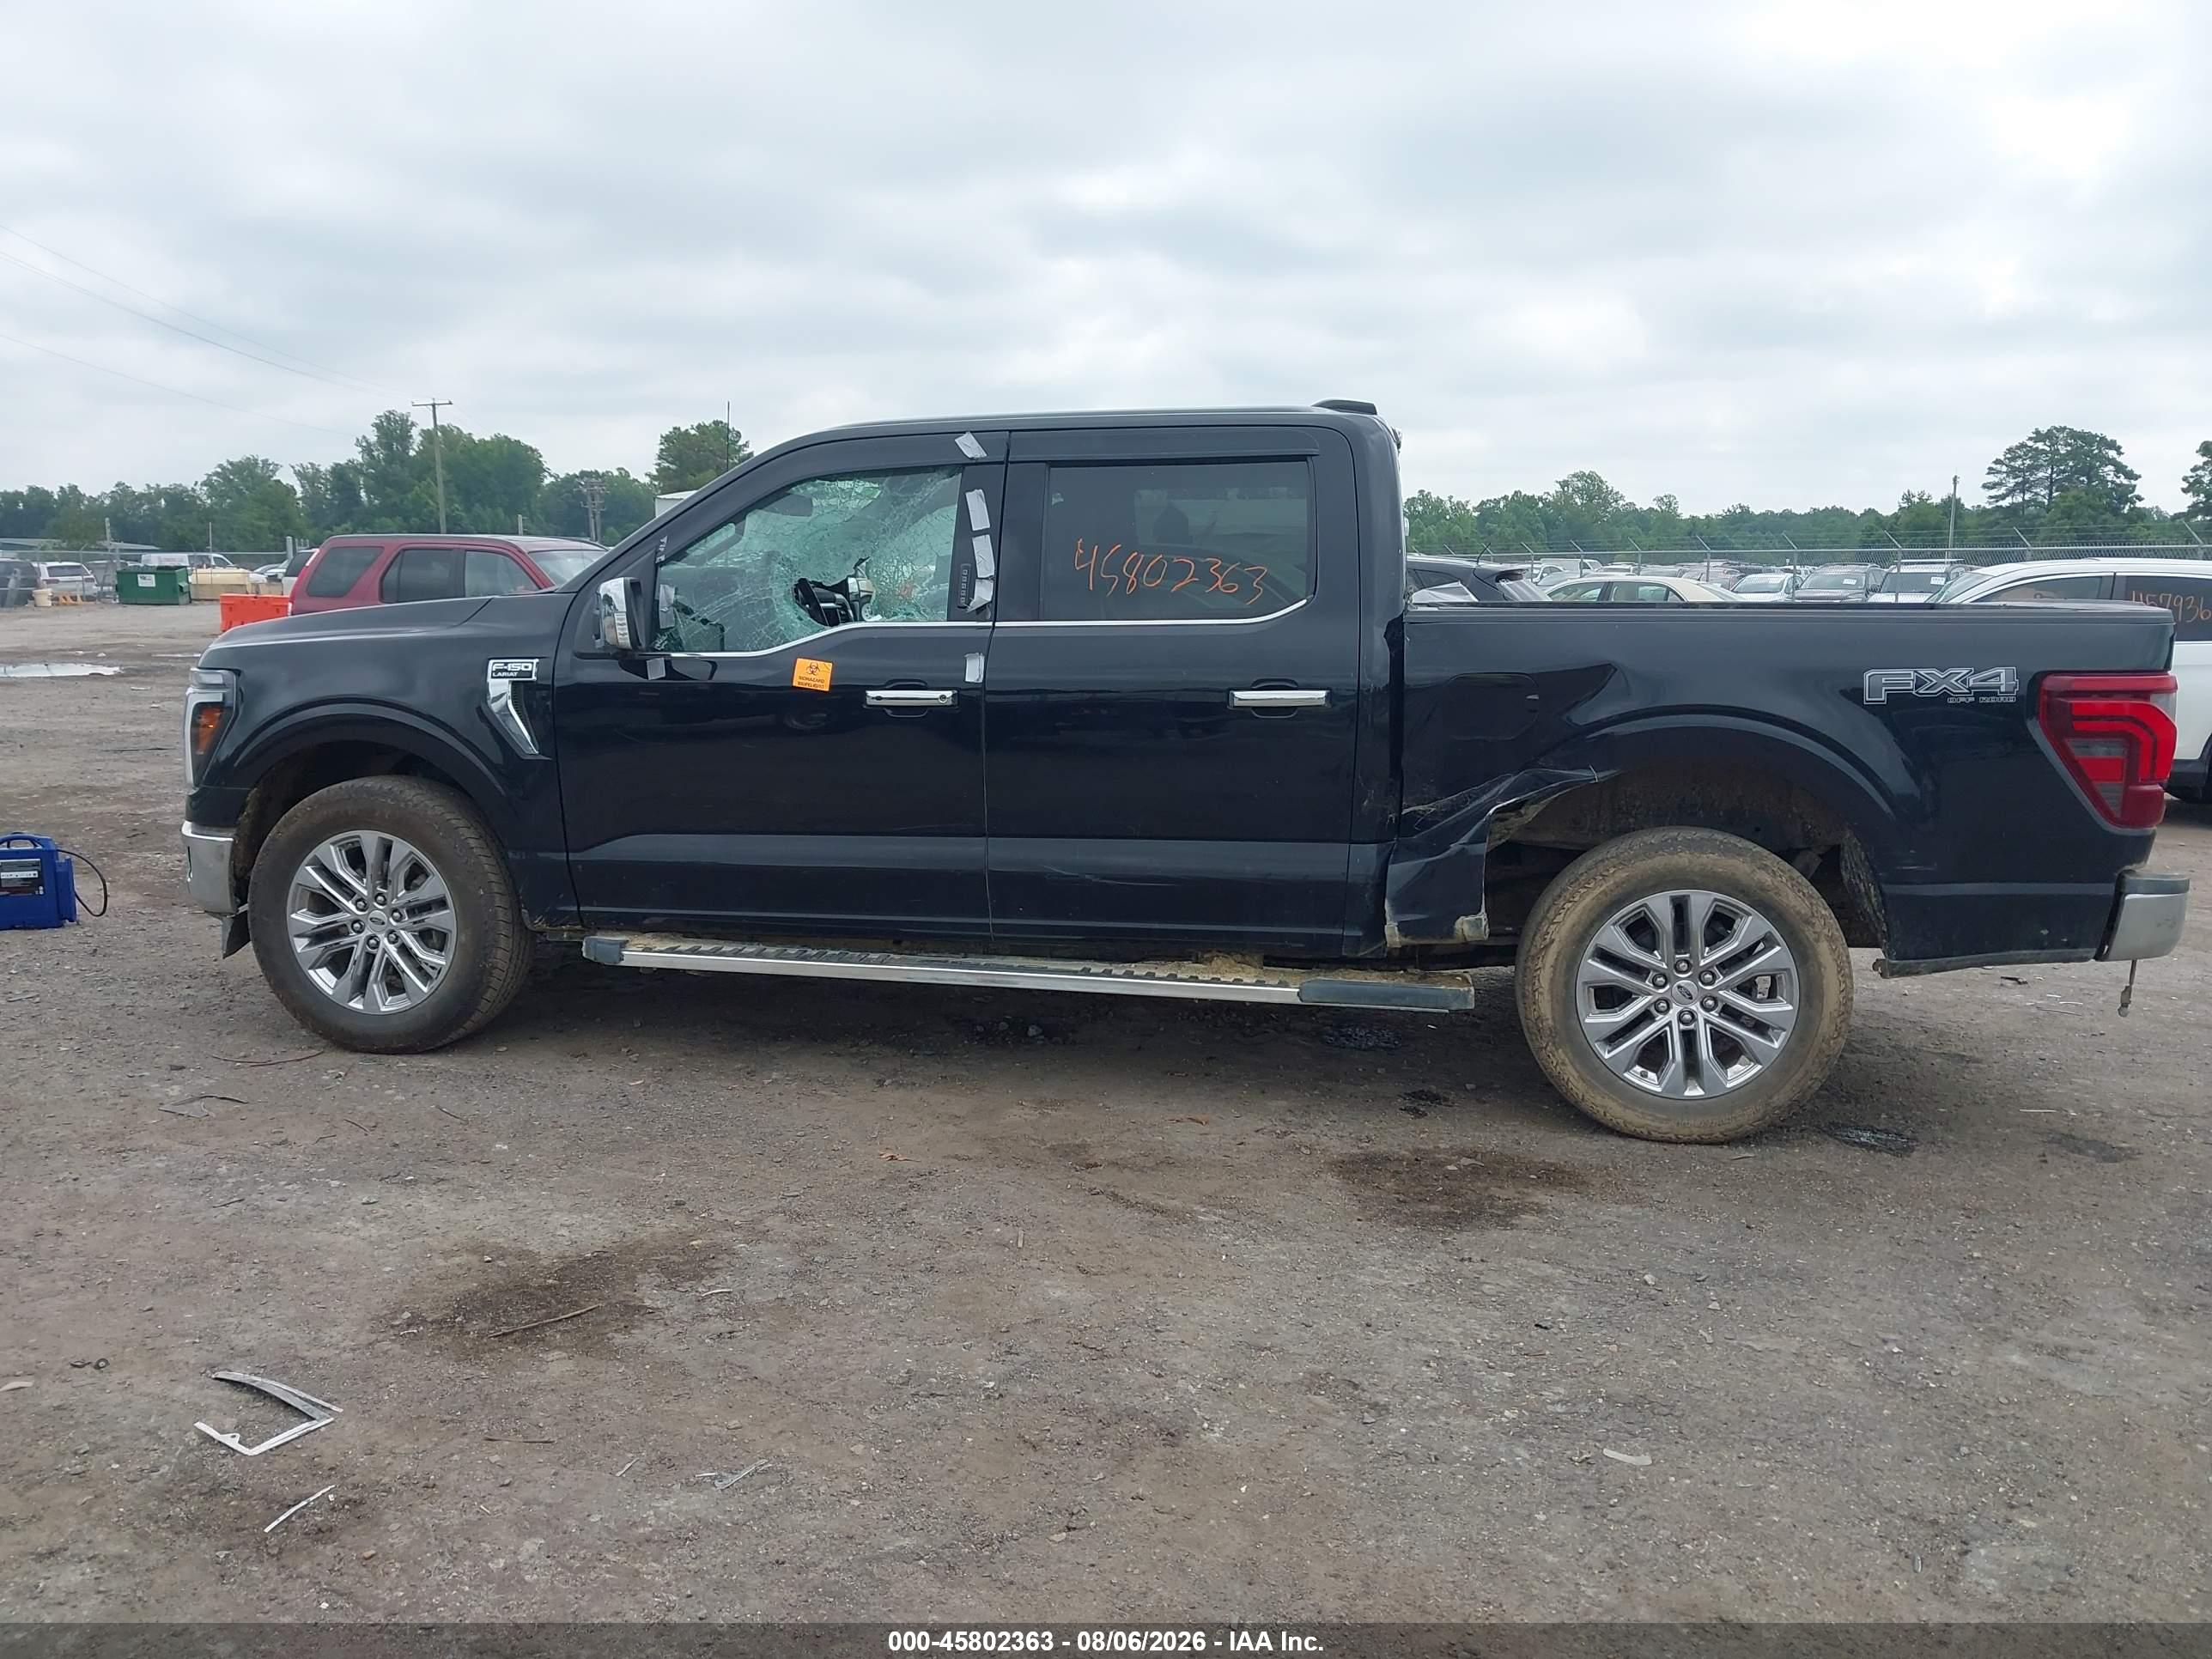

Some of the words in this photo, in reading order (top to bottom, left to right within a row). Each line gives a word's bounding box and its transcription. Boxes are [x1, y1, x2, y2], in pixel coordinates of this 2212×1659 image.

[1074, 538, 1267, 605] 45802363
[492, 662, 532, 672] F-150
[1863, 666, 2020, 705] FX4
